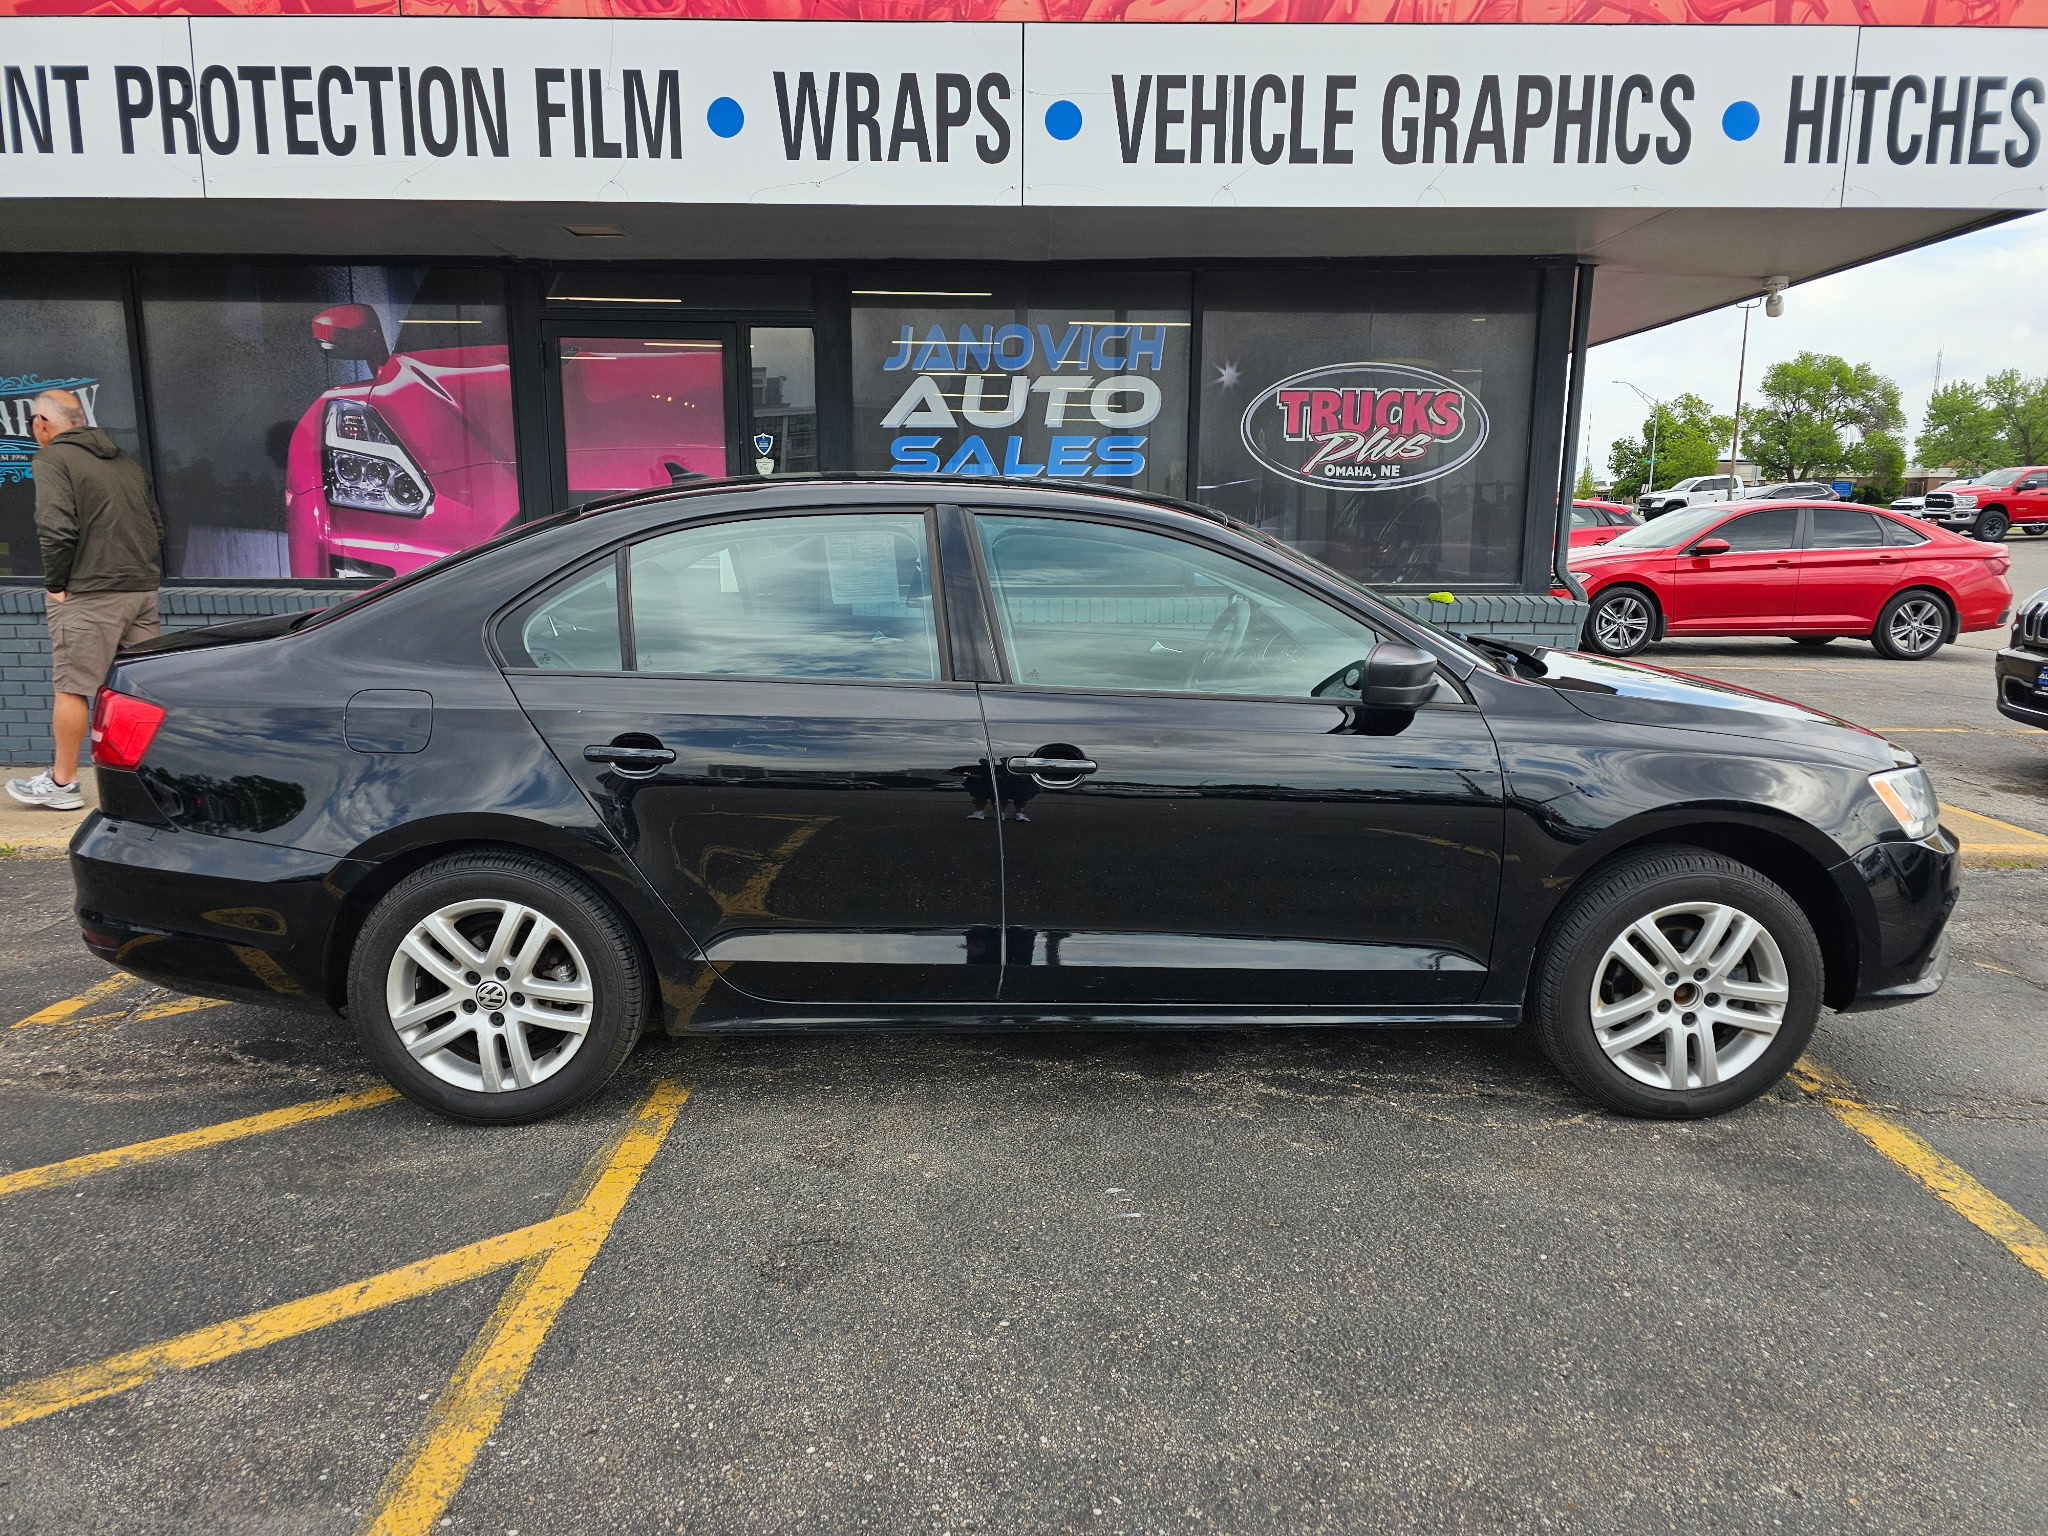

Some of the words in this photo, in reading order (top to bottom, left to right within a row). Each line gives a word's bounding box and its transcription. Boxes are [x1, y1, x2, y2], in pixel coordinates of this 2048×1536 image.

[0, 65, 89, 154] NT
[114, 65, 509, 158] PROTECTION
[535, 68, 682, 159] FILM
[773, 71, 1011, 164] WRAPS
[1112, 73, 1356, 165] VEHICLE
[1382, 73, 1695, 165] GRAPHICS
[1784, 74, 2046, 168] HITCHES
[883, 323, 1166, 371] JANOVICH
[880, 375, 1162, 428] AUTO
[1278, 389, 1465, 442] TRUCKS
[889, 434, 1148, 476] SALES
[1301, 425, 1434, 475] Plus
[1380, 465, 1401, 477] NE
